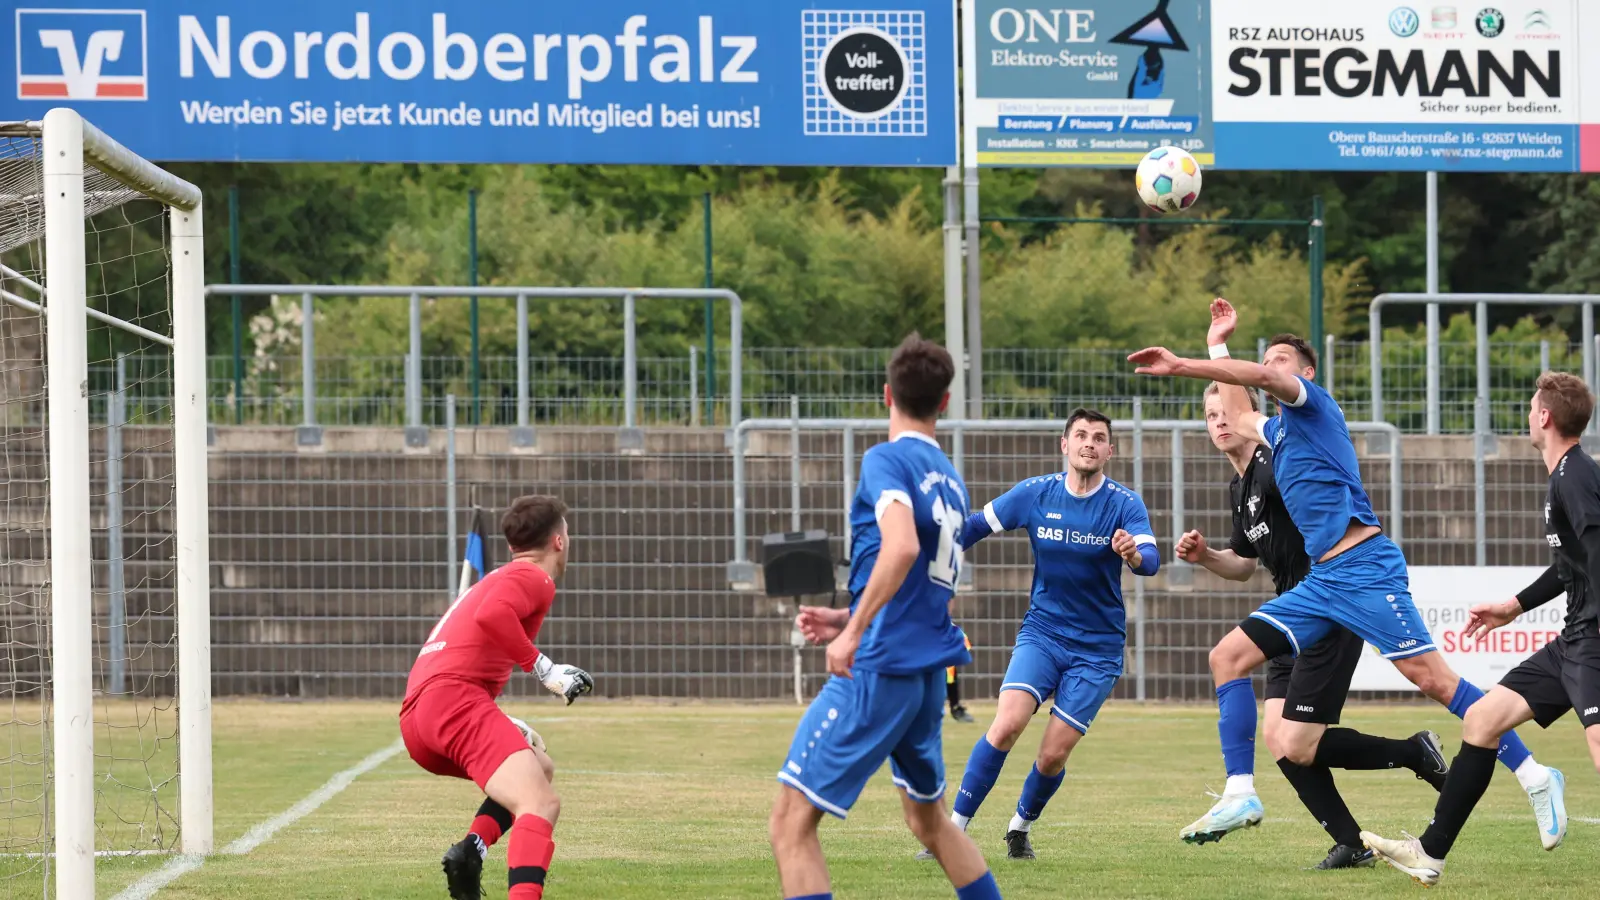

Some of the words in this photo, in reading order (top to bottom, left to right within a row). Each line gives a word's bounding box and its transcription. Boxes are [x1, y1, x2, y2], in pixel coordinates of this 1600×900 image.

[990, 8, 1096, 44] ONE
[1229, 27, 1261, 41] RSZ
[1268, 28, 1364, 42] AUTOHAUS
[179, 12, 759, 99] Nordoberpfalz
[846, 52, 883, 69] Voll-
[991, 50, 1118, 67] Elektro-Service
[1086, 72, 1118, 82] GmbH
[1227, 47, 1561, 98] STEGMANN
[835, 75, 895, 91] treffer!
[1420, 101, 1460, 113] Sicher
[1465, 104, 1502, 116] super
[1507, 102, 1562, 114] bedient.
[180, 100, 283, 125] Werden
[290, 102, 327, 125] Sie
[334, 102, 392, 131] jetzt
[400, 102, 482, 127] Kunde
[489, 103, 539, 127] und
[547, 103, 653, 133] Mitglied
[661, 103, 699, 128] bei
[707, 106, 761, 129] uns!
[1004, 119, 1053, 131] Beratung
[1069, 119, 1113, 132] Planung
[1131, 119, 1192, 132] Ausführung
[987, 138, 1045, 148] Installation
[1056, 138, 1078, 148] KNX
[1090, 138, 1149, 149] Smarthome
[1329, 131, 1366, 144] Obere
[1368, 131, 1460, 145] Bauscherstraße
[1462, 132, 1475, 144] 16
[1482, 132, 1515, 145] 92637
[1517, 133, 1562, 145] Weiden
[1338, 146, 1360, 158] Tel.
[1361, 146, 1423, 158] 0961/4040
[1431, 147, 1563, 160] www.rsz-stegmann.de
[1046, 512, 1062, 520] JAKO
[1037, 526, 1063, 541] SAS
[1071, 530, 1111, 546] Softec
[1398, 639, 1417, 649] JAKO
[1295, 704, 1314, 713] JAKO
[1584, 706, 1600, 716] JAKO
